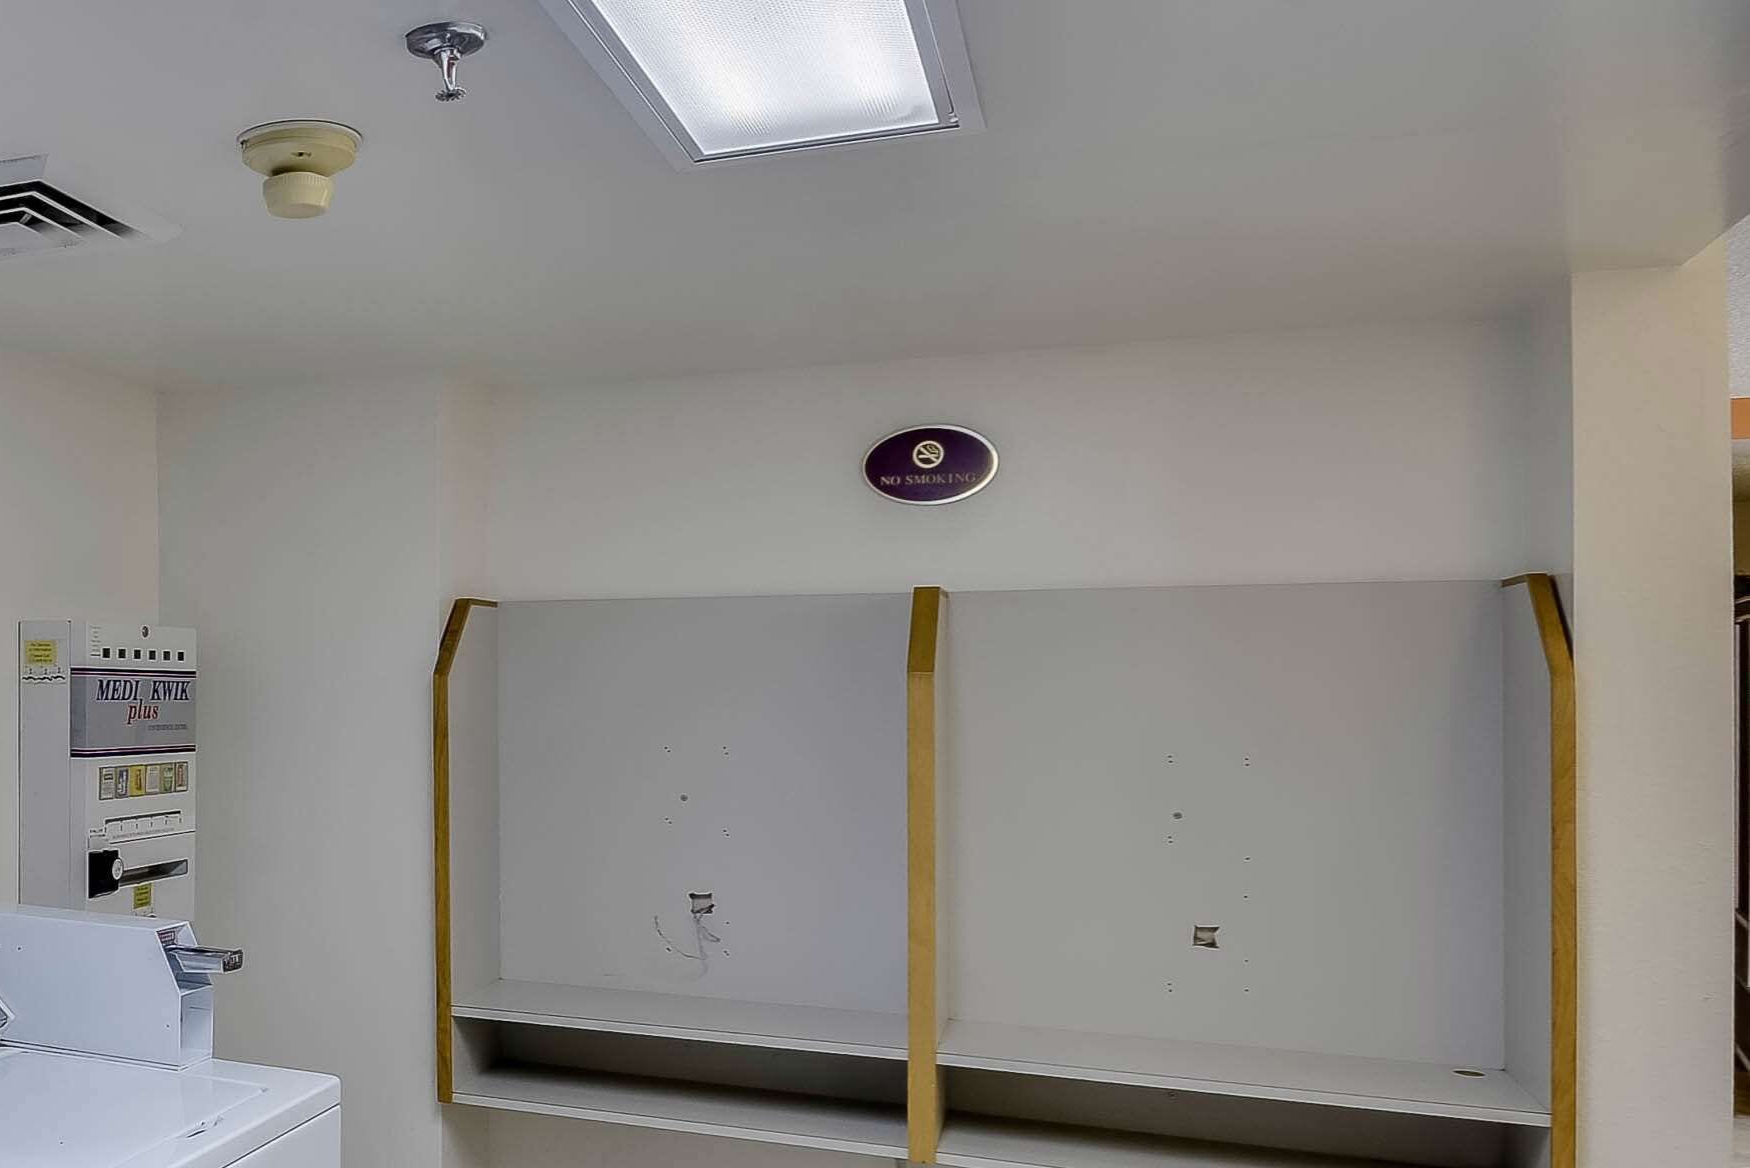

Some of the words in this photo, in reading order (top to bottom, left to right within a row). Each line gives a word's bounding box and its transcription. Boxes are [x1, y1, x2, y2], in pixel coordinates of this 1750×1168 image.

[879, 475, 901, 486] NO
[905, 472, 976, 486] SMOKING
[96, 679, 140, 701] MEDI
[150, 680, 191, 701] KWIK
[127, 699, 159, 725] plus
